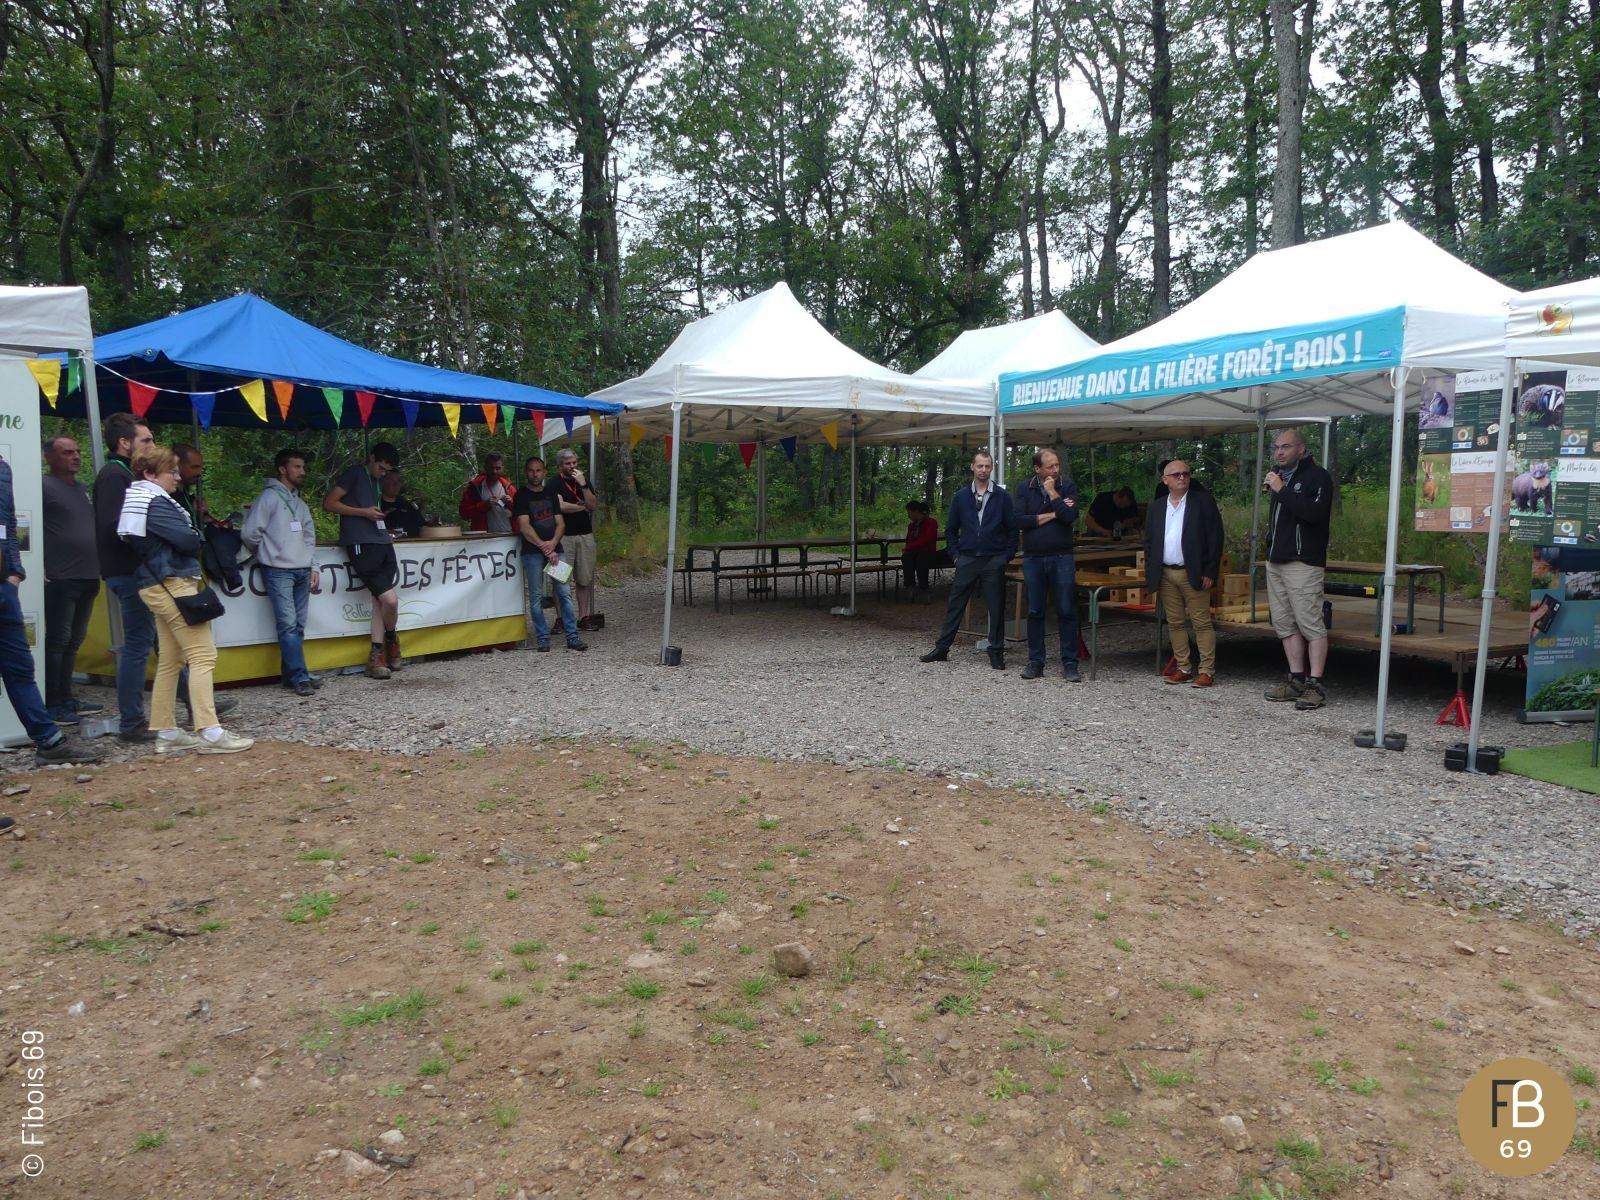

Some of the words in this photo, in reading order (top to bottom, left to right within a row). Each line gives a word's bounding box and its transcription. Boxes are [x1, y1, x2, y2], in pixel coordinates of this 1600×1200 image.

[1012, 374, 1083, 406] BIENVENUE
[1085, 368, 1128, 398] DANS
[1129, 365, 1151, 393] LA
[1154, 352, 1219, 390] FILIÈRE
[1221, 332, 1347, 382] FORÊT-BOIS
[1352, 330, 1363, 363] !
[442, 547, 517, 585] FÊTES
